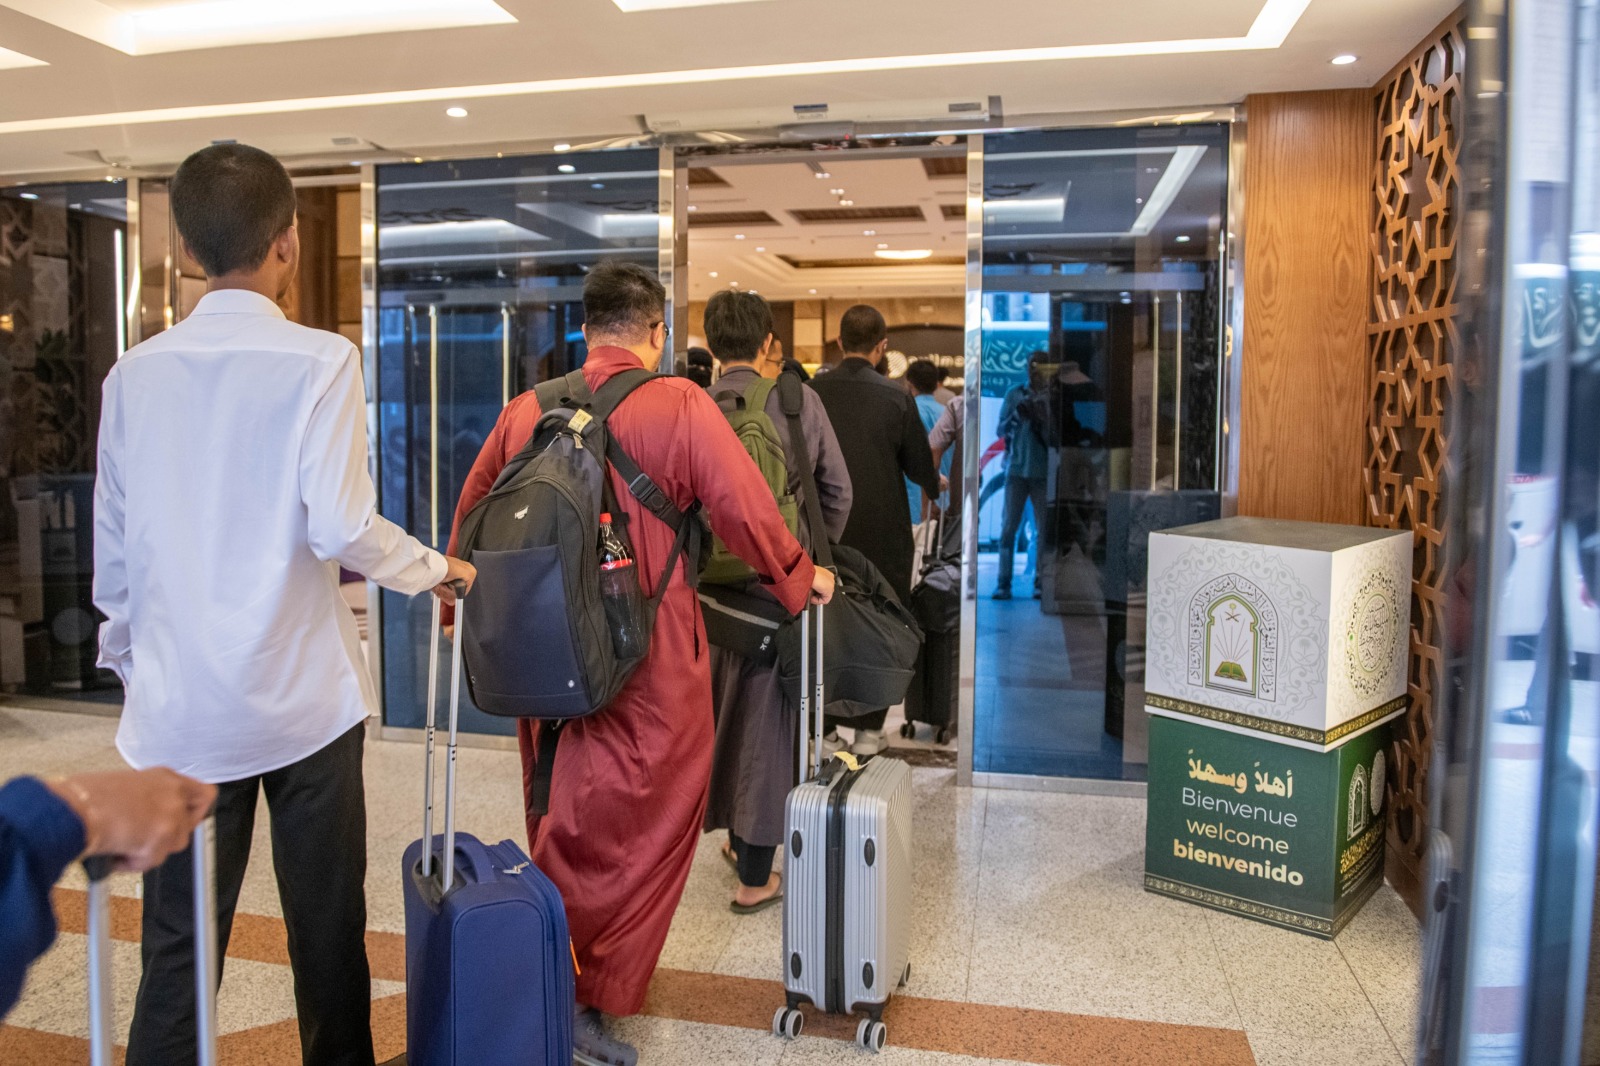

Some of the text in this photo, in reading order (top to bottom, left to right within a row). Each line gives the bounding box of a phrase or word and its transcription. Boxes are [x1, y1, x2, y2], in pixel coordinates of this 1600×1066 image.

[1182, 787, 1298, 828] Bienvenue
[1186, 818, 1290, 855] welcome
[1173, 838, 1304, 886] bienvenido
